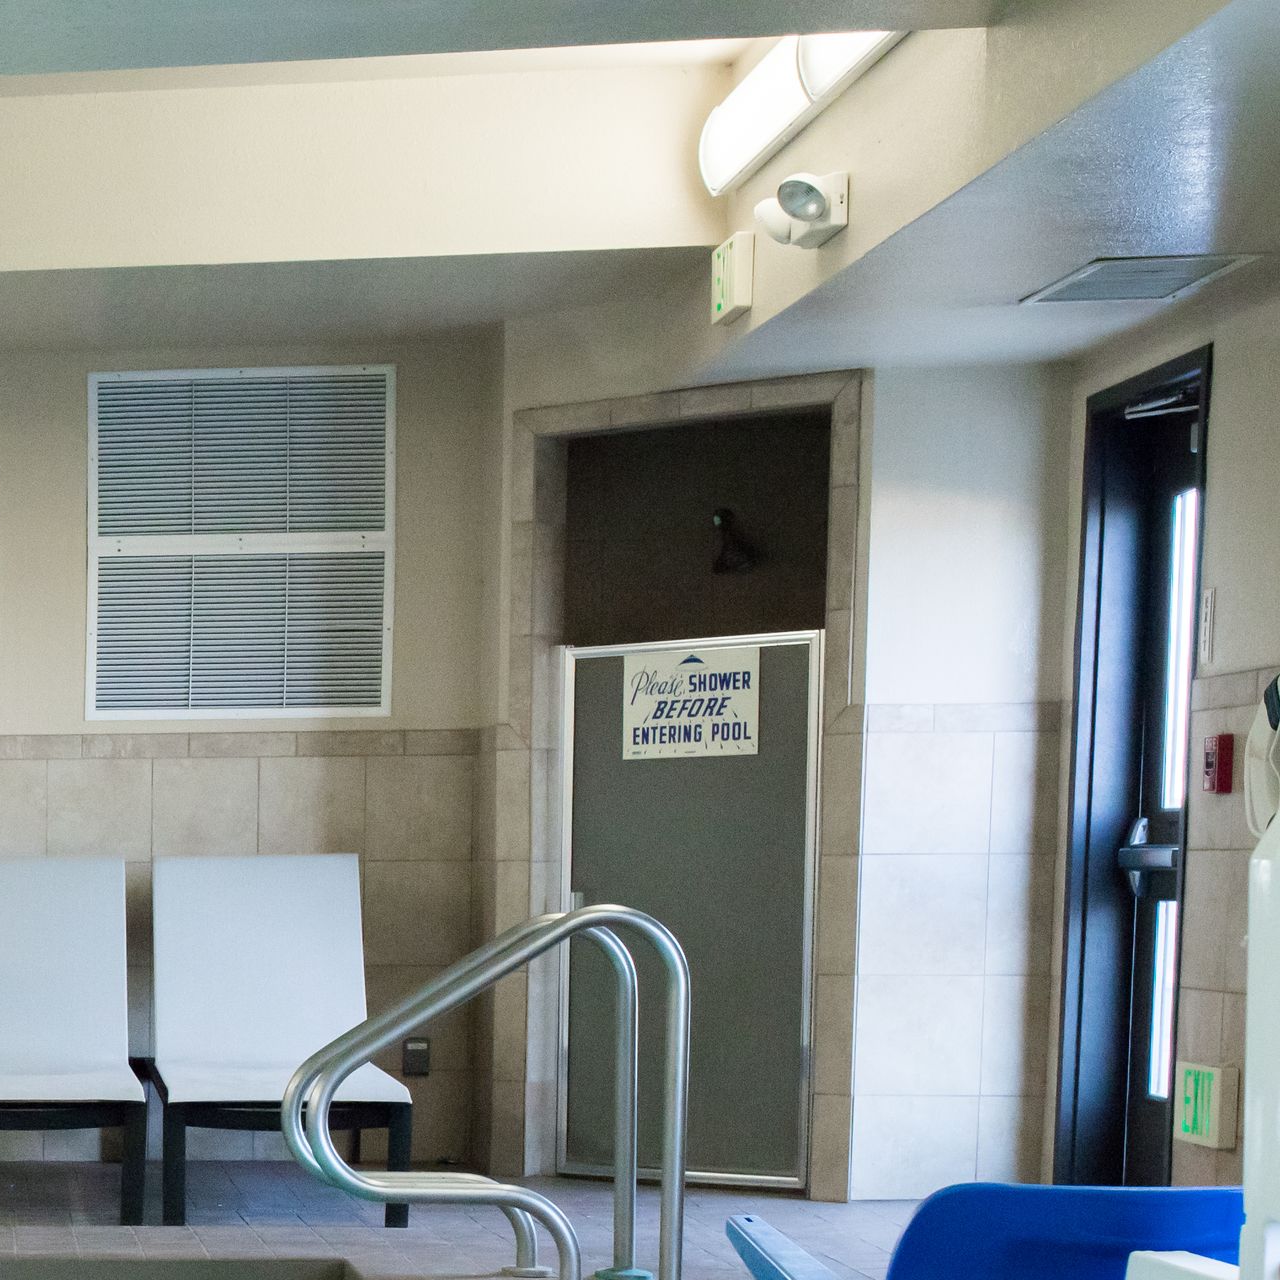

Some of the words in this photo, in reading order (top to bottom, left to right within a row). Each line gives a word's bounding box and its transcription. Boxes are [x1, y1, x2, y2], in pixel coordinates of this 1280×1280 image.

[630, 665, 685, 706] Please
[688, 671, 751, 693] SHOWER
[652, 696, 732, 720] BEFORE
[632, 724, 703, 746] ENTERING
[711, 721, 752, 742] POOL
[1181, 1068, 1215, 1137] EXIT
